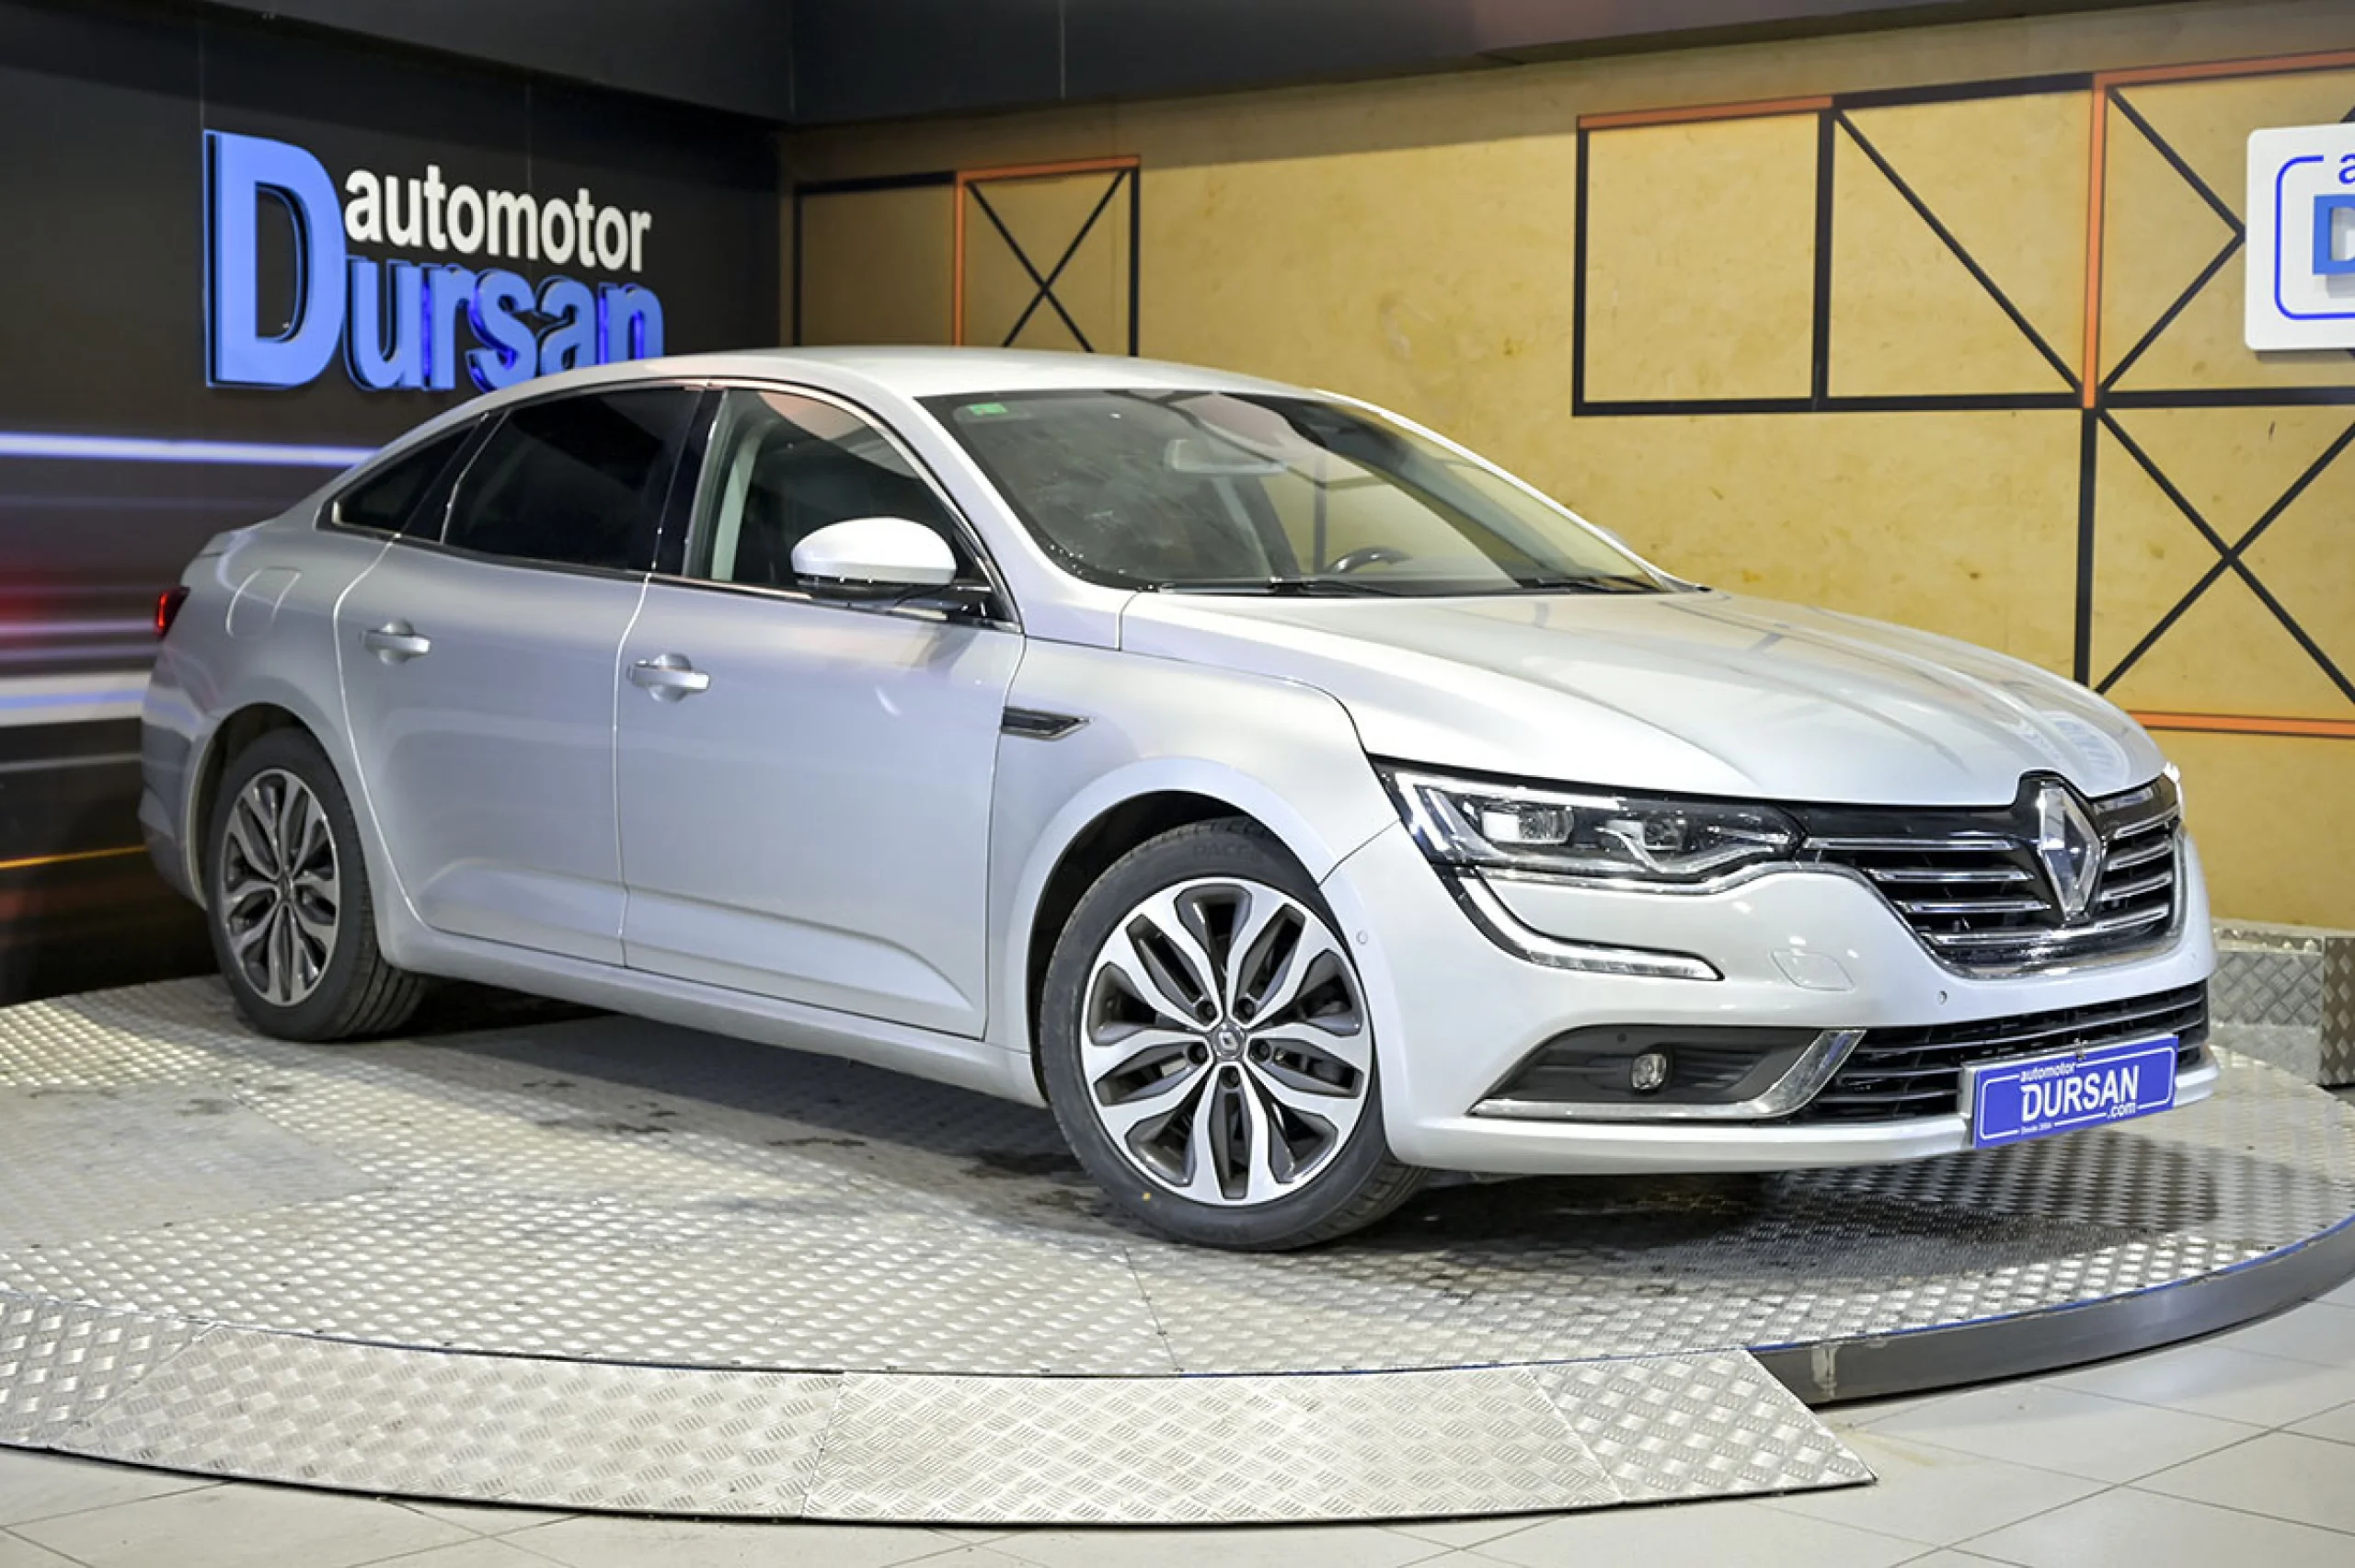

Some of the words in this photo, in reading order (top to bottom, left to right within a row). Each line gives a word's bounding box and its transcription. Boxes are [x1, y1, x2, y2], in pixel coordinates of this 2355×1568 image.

[345, 165, 652, 272] automotor
[203, 129, 664, 391] Dursan
[2020, 1062, 2076, 1082] automotor
[2020, 1065, 2140, 1123] DURSAN
[2107, 1102, 2136, 1119] .com
